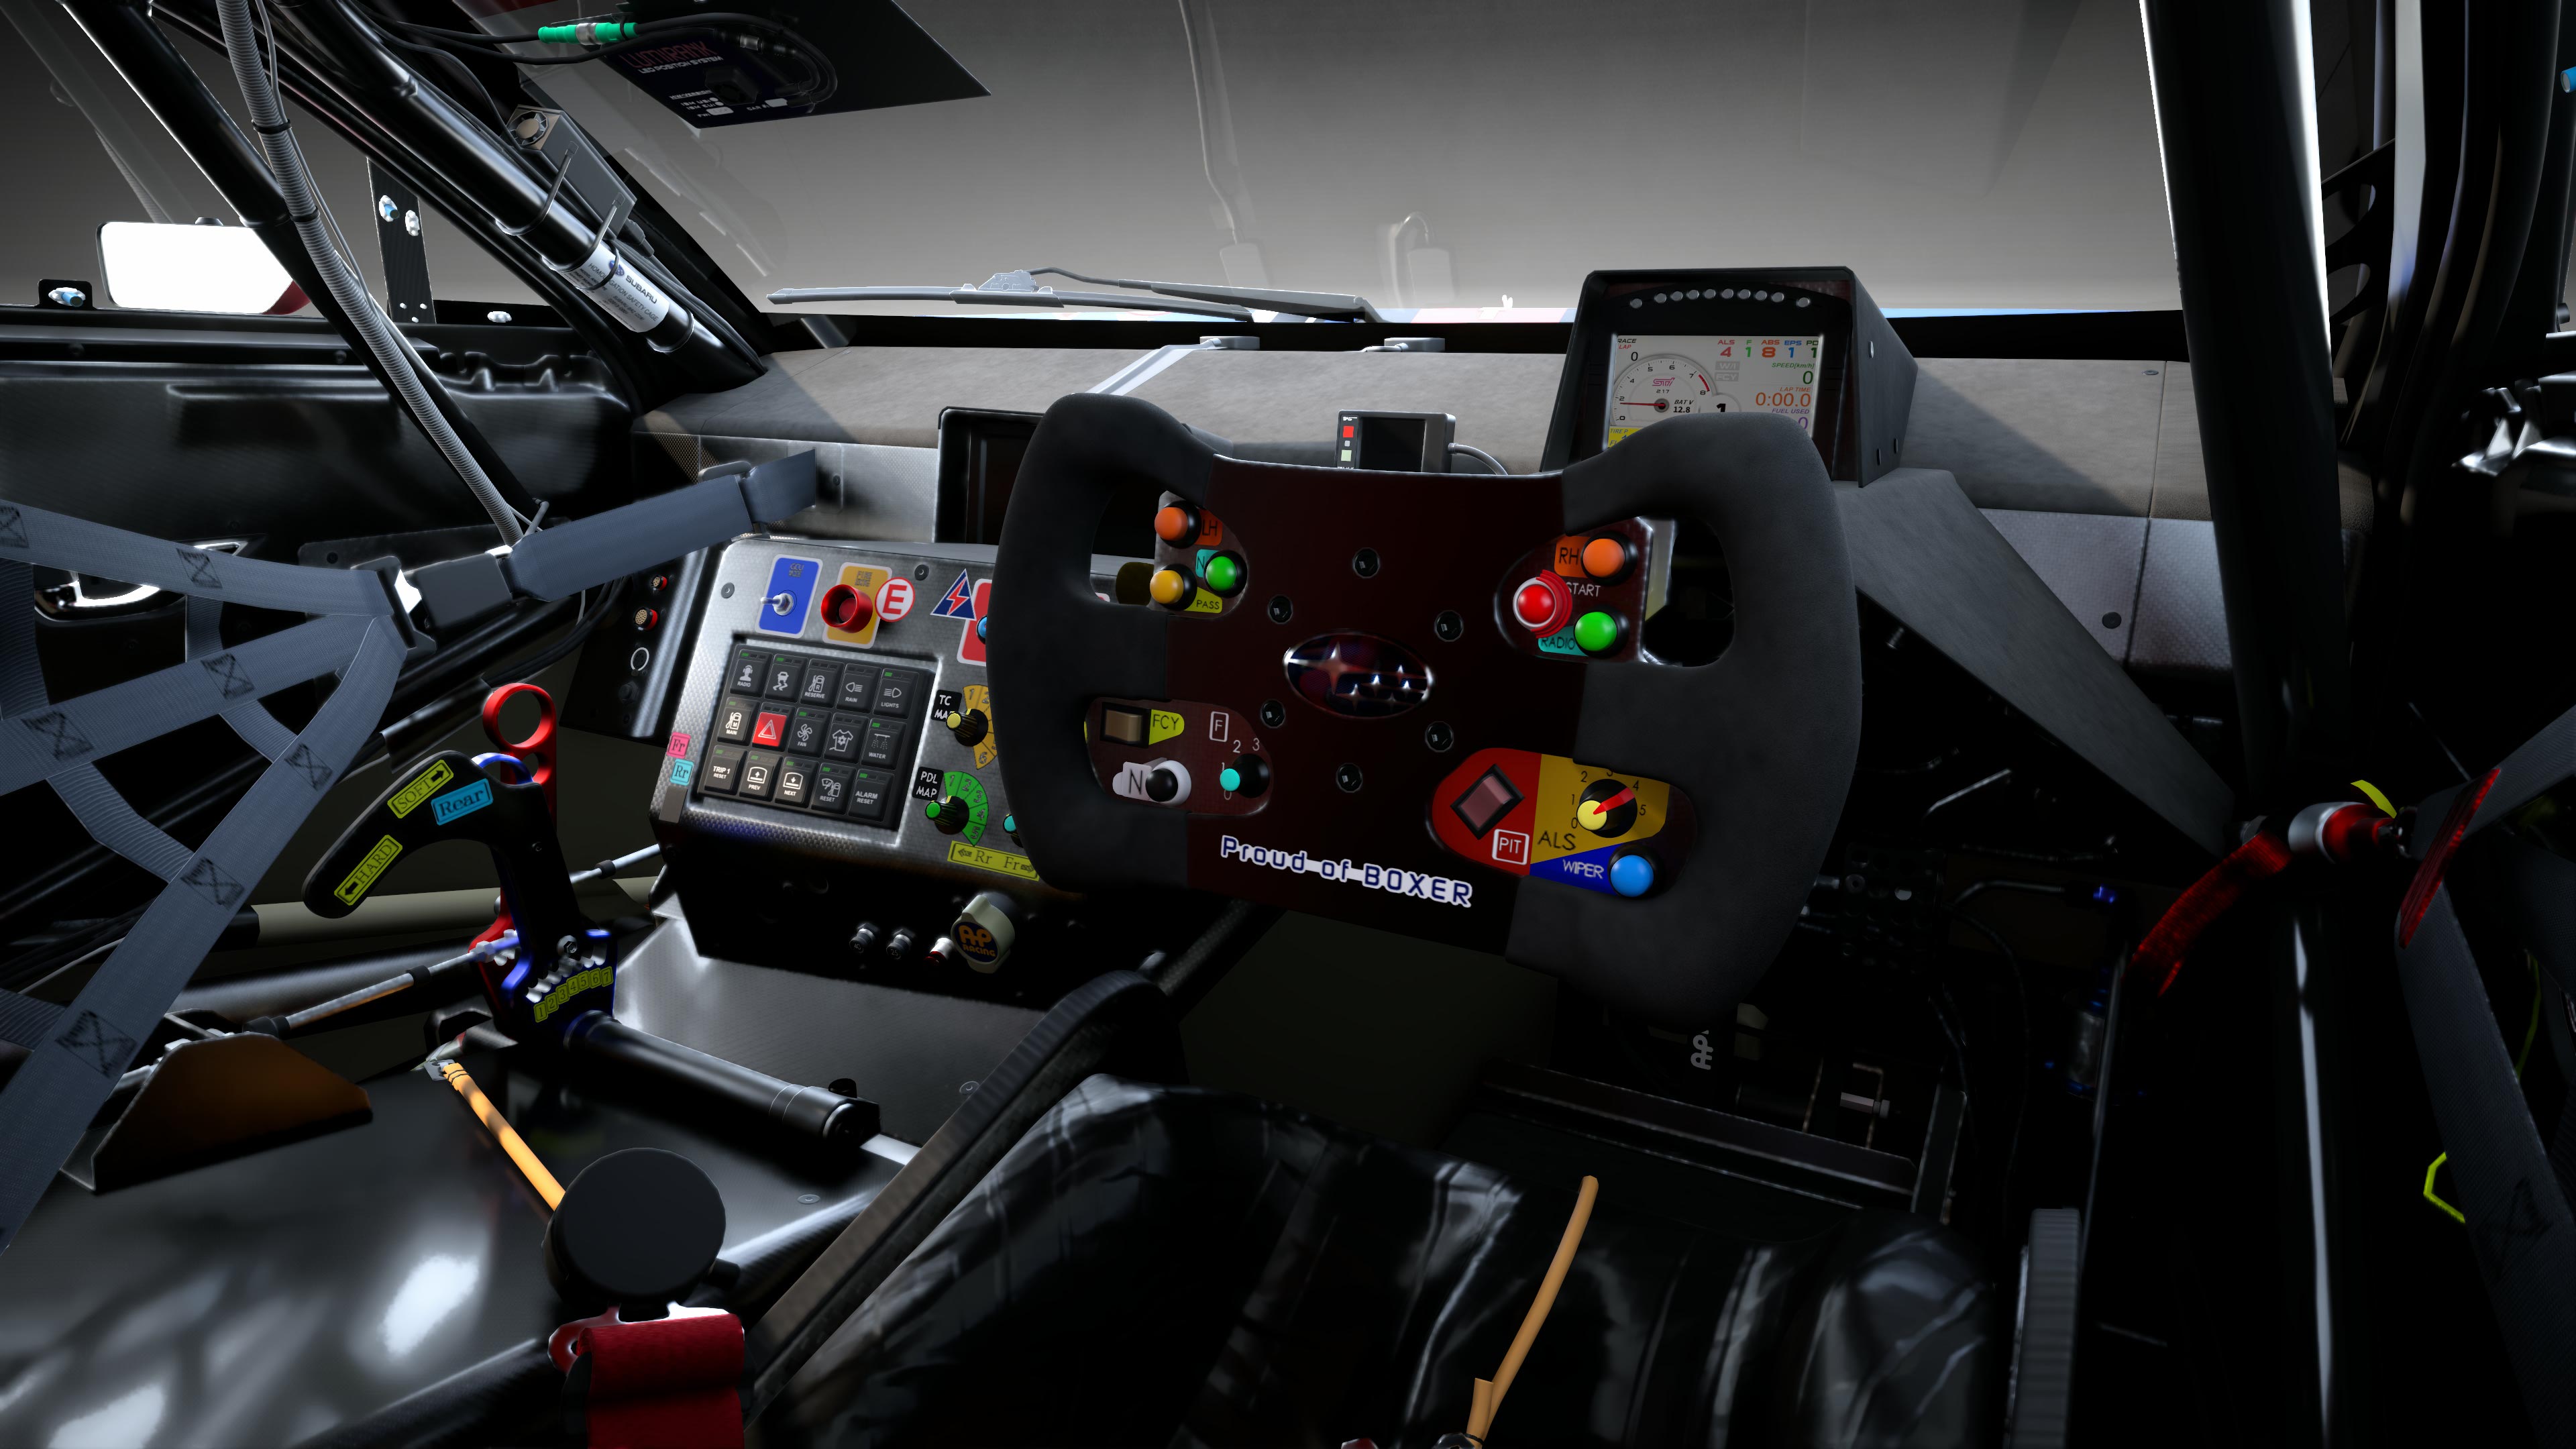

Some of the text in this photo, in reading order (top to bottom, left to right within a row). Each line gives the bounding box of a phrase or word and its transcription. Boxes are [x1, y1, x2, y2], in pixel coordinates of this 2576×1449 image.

[653, 61, 690, 72] POSITION
[688, 56, 724, 66] SYSTEM
[625, 275, 657, 304] SUBARU
[626, 294, 646, 311] SAFETY
[644, 309, 659, 322] CAGE
[1631, 352, 1638, 361] 0
[1720, 347, 1817, 358] 4 1 8 1 1
[1803, 371, 1813, 384] 0
[1756, 392, 1811, 407] 0:00.0
[1201, 519, 1218, 537] LH
[1559, 547, 1580, 566] RH
[882, 584, 908, 615] E
[1196, 600, 1220, 610] PASS
[1541, 637, 1575, 650] RADIO
[939, 694, 952, 706] TC
[1152, 714, 1179, 731] FCY
[1215, 719, 1223, 732] F
[672, 739, 685, 752] Fr
[1233, 738, 1260, 753] 2 3
[979, 751, 987, 764] 6
[675, 765, 689, 778] Rr
[920, 771, 937, 784] PDL
[1580, 771, 1588, 782] 2
[949, 775, 955, 786] 1
[962, 779, 971, 791] 2
[1129, 768, 1143, 795] N
[1633, 780, 1640, 790] 4
[396, 778, 432, 809] SOFT
[855, 791, 879, 800] ALARM
[916, 786, 937, 798] MAP
[973, 790, 983, 803] 3
[439, 788, 484, 816] Rear
[1571, 794, 1575, 805] 1
[976, 807, 985, 820] 4
[1639, 804, 1646, 816] 5
[971, 826, 980, 839] 5
[1499, 837, 1522, 854] PIT
[1538, 830, 1576, 851] ALS
[973, 850, 993, 865] Rr
[1004, 857, 1021, 871] Fr
[354, 845, 392, 884] HARD
[1222, 837, 1470, 905] Proud of BOXER
[1562, 859, 1605, 879] WIPER
[958, 924, 992, 948] AP
[961, 944, 997, 958] RACING
[570, 982, 576, 991] 4
[580, 977, 587, 985] 5
[592, 973, 598, 982] 6
[604, 971, 610, 980] 7
